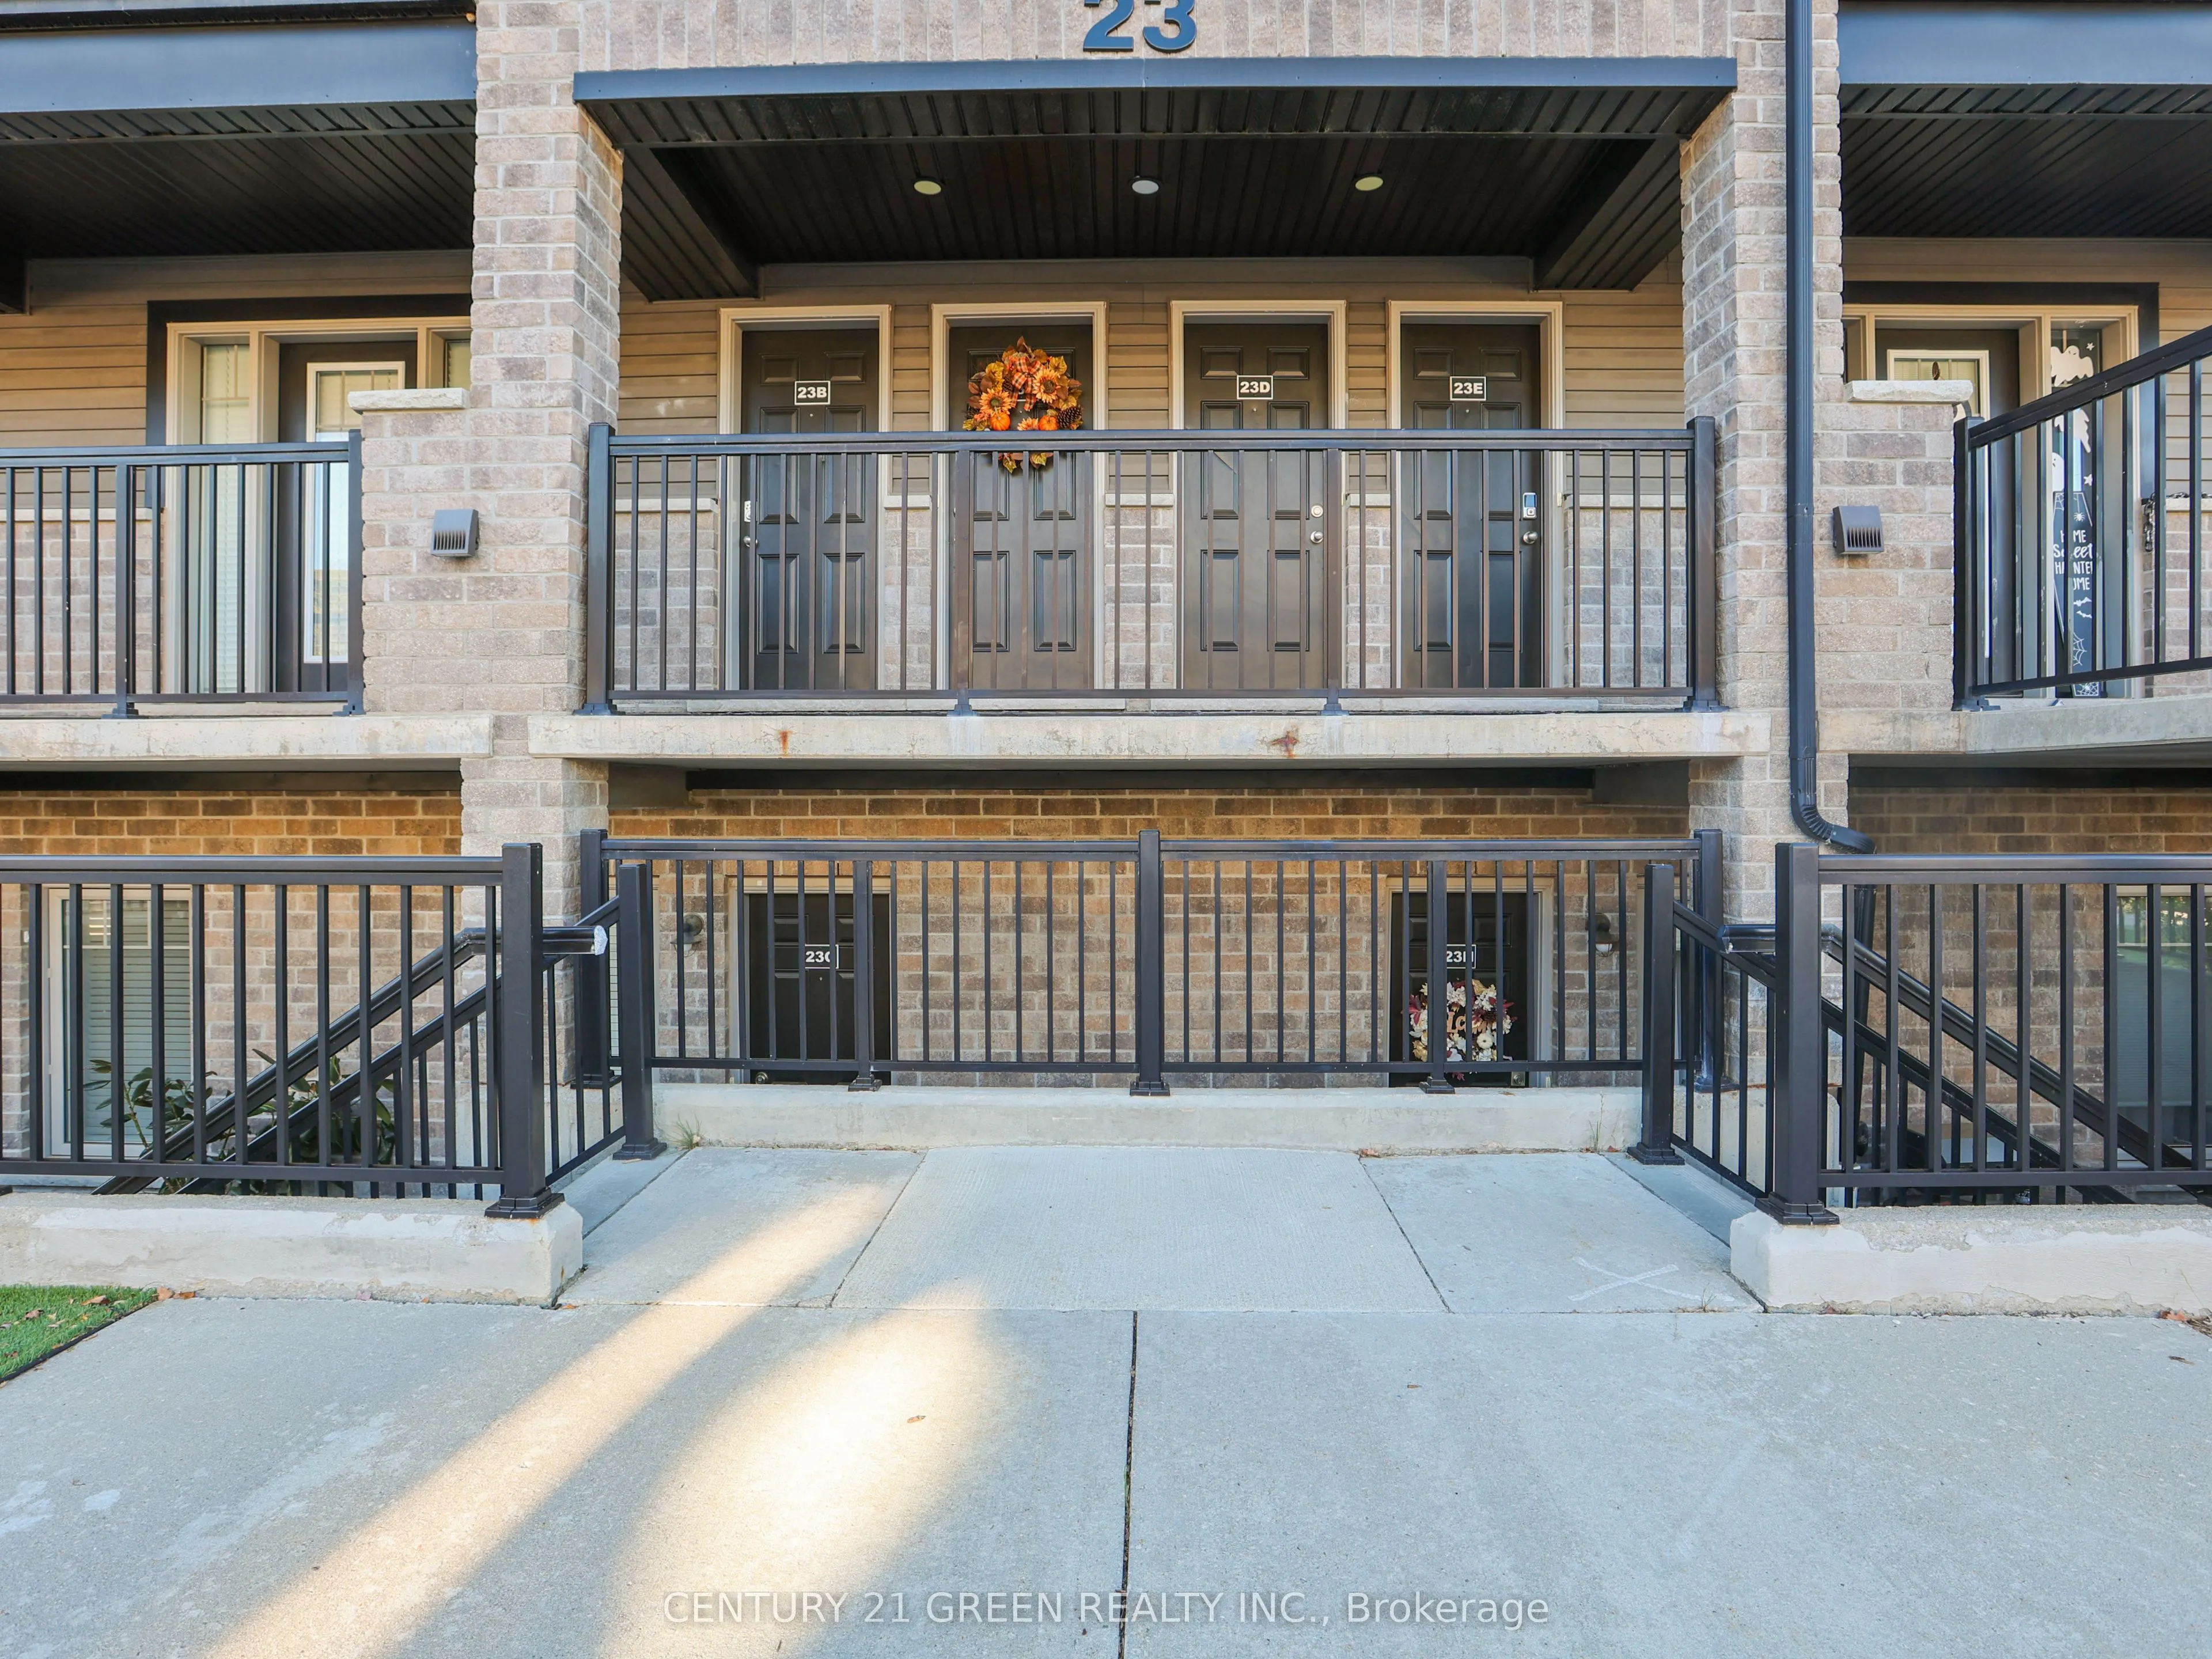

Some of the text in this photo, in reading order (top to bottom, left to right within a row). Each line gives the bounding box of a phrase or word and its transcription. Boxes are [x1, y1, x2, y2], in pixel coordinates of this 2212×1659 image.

[1083, 0, 1197, 52] 23
[797, 387, 827, 399] 23B
[1240, 381, 1270, 393] 23D
[1454, 382, 1483, 394] 23E
[2053, 543, 2092, 559] Seet
[2055, 561, 2092, 574] HNTE
